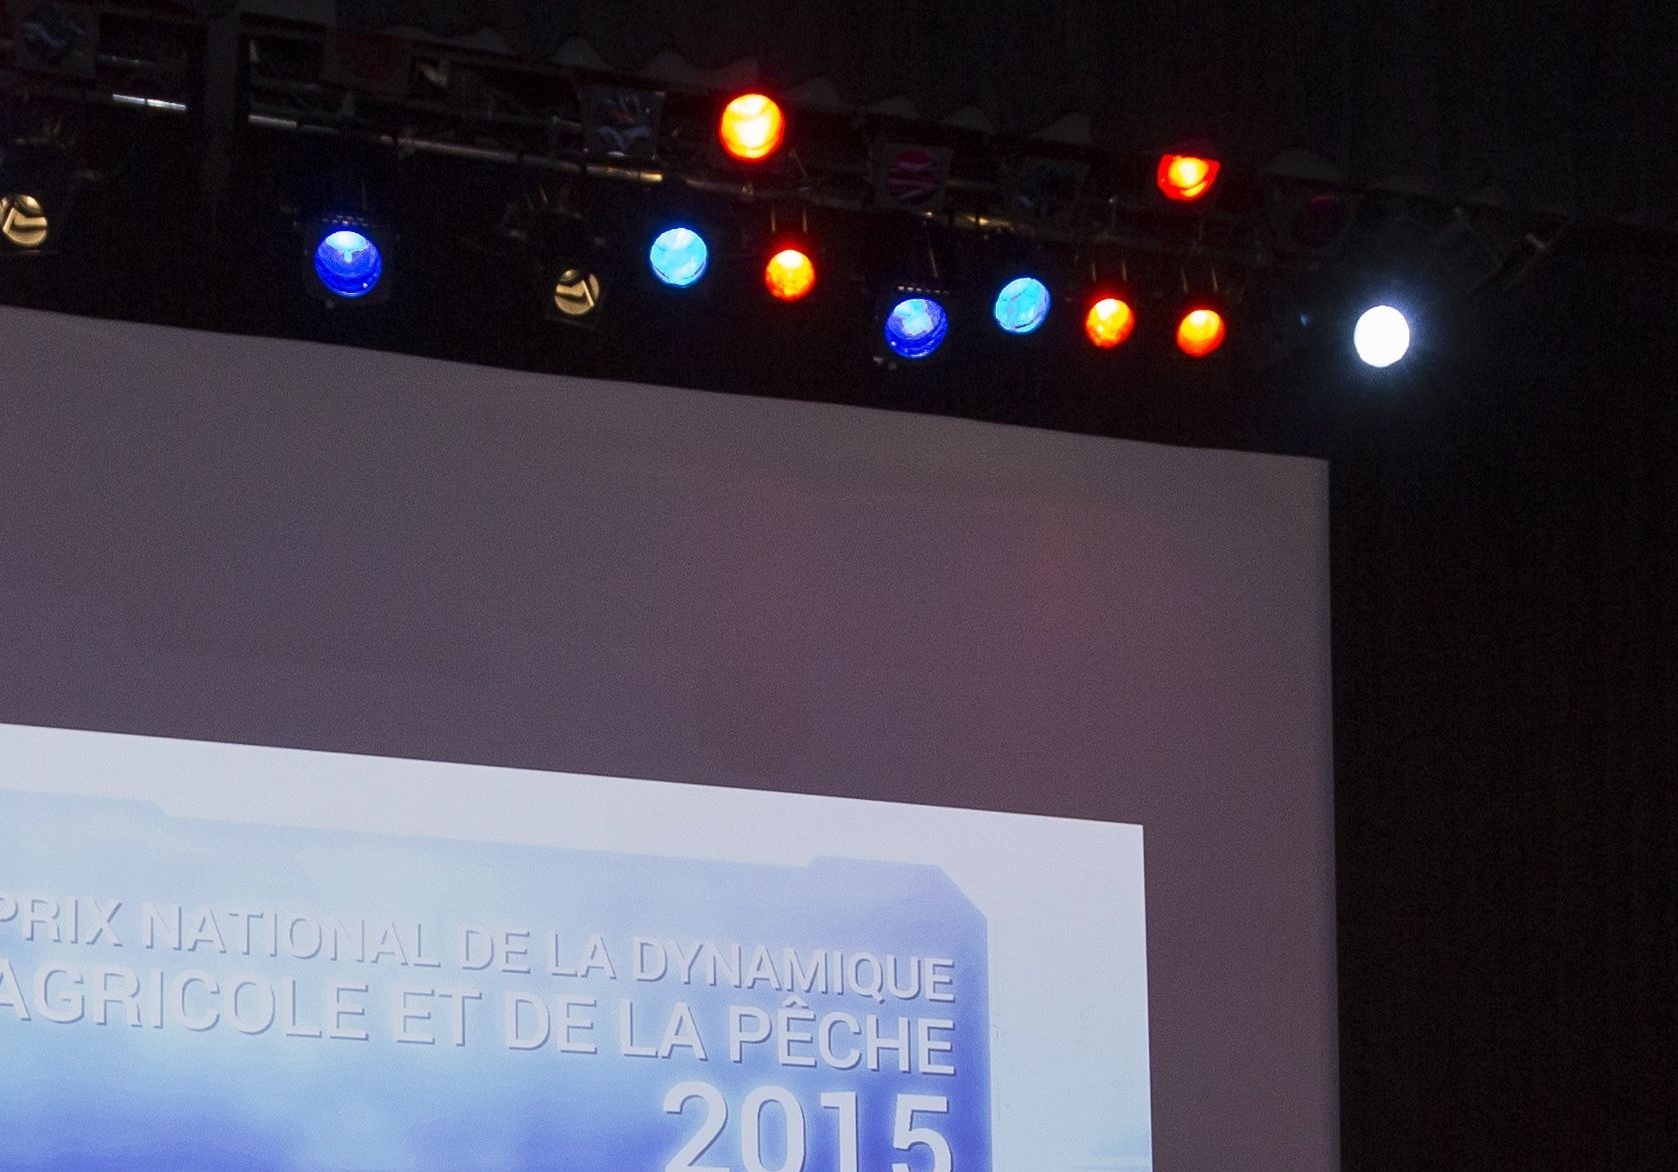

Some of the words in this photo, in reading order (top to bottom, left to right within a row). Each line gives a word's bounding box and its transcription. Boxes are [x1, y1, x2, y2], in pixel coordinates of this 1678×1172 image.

[141, 901, 442, 968] NATIONAL
[458, 925, 532, 975] DE
[546, 931, 617, 980] LA
[631, 935, 956, 1004] DYNAMIQUE
[394, 977, 483, 1048] ET
[504, 989, 598, 1055] DE
[621, 996, 709, 1062] LA
[729, 993, 956, 1077] PÊCHE
